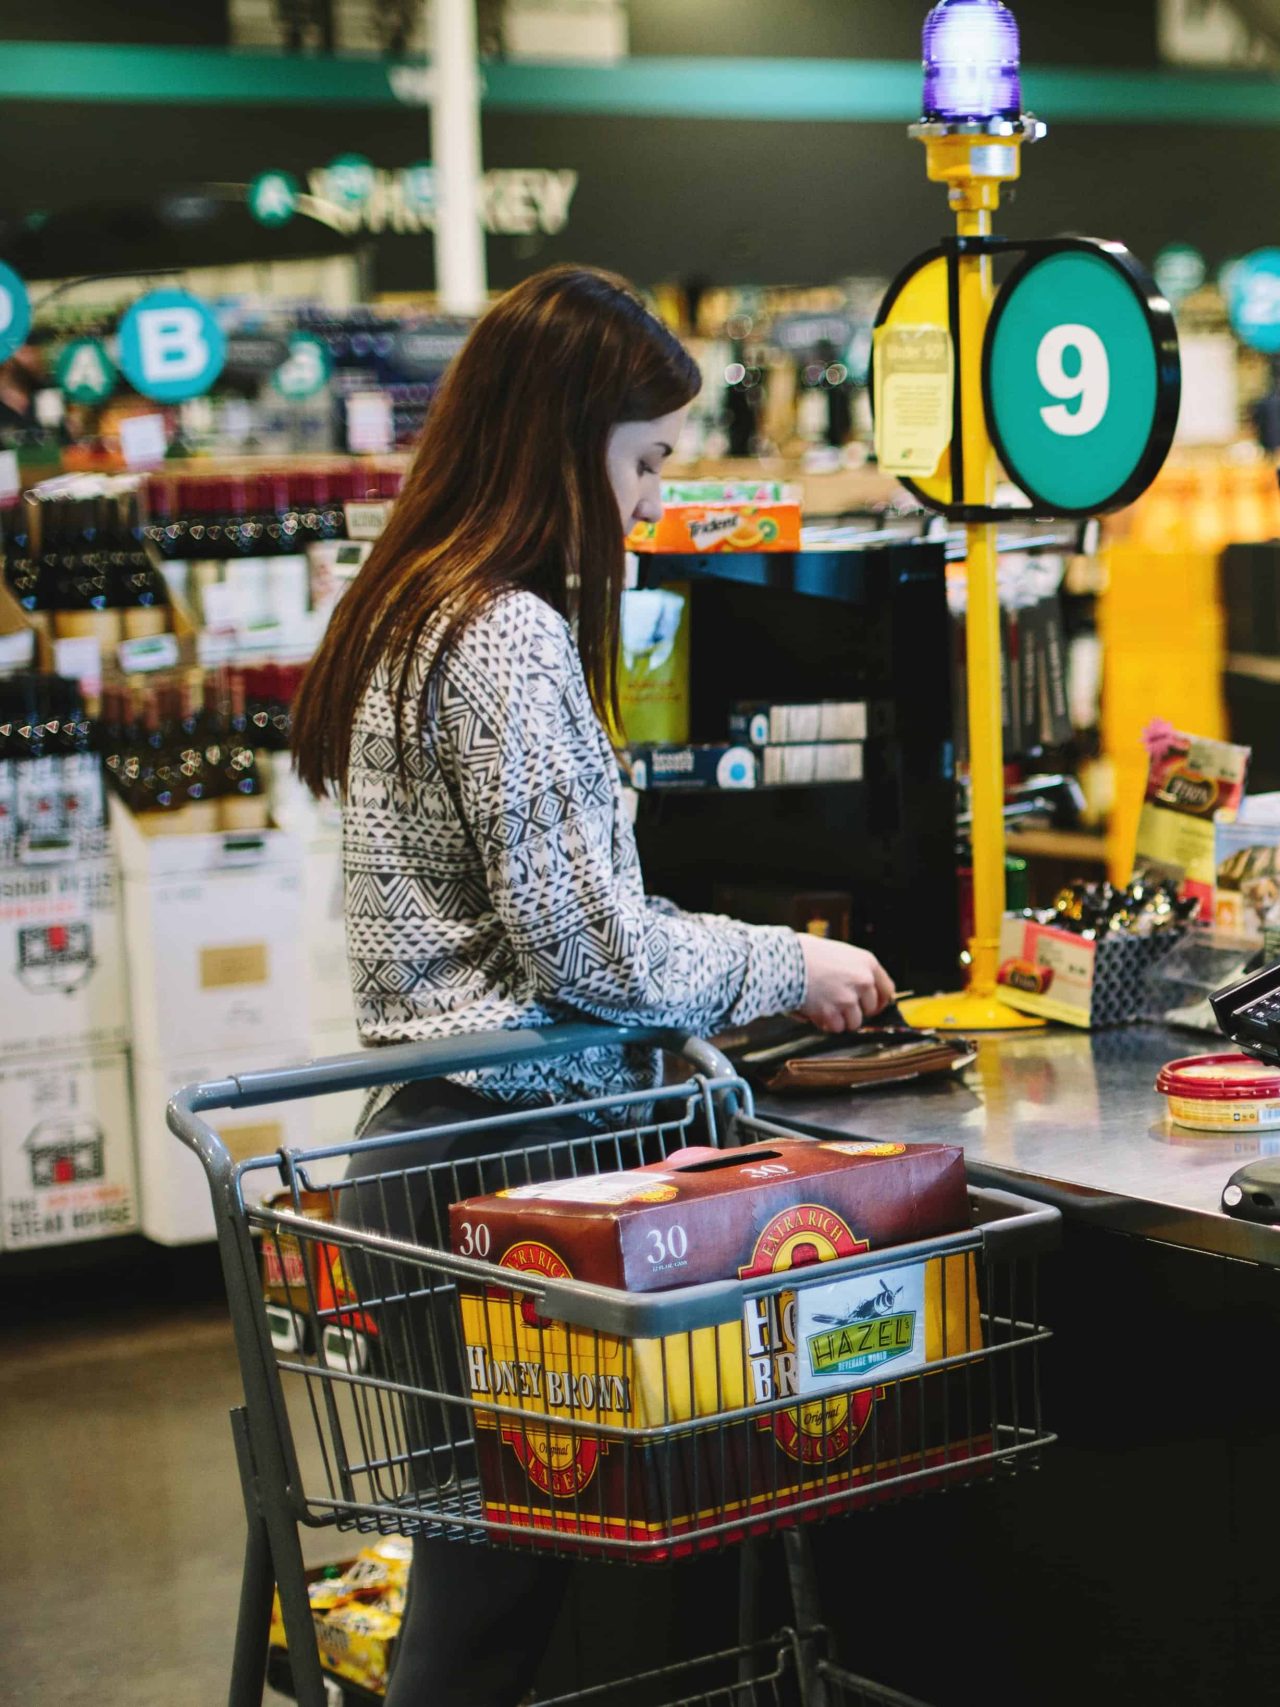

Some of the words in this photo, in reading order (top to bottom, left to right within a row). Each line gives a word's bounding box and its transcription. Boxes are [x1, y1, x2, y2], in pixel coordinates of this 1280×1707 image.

[136, 307, 209, 384] B
[66, 343, 108, 392] A
[1036, 323, 1110, 437] 9
[688, 515, 738, 538] Trident
[740, 1165, 789, 1178] 30
[460, 1222, 490, 1257] 30
[646, 1225, 688, 1264] 30
[762, 1211, 804, 1257] EXTRA
[808, 1210, 843, 1243] RICH
[466, 1346, 542, 1396] HONEY
[545, 1370, 632, 1411] BROWN
[838, 1356, 866, 1371] BEVERAGE
[868, 1351, 888, 1365] WORLD
[804, 1404, 840, 1426] Orignal
